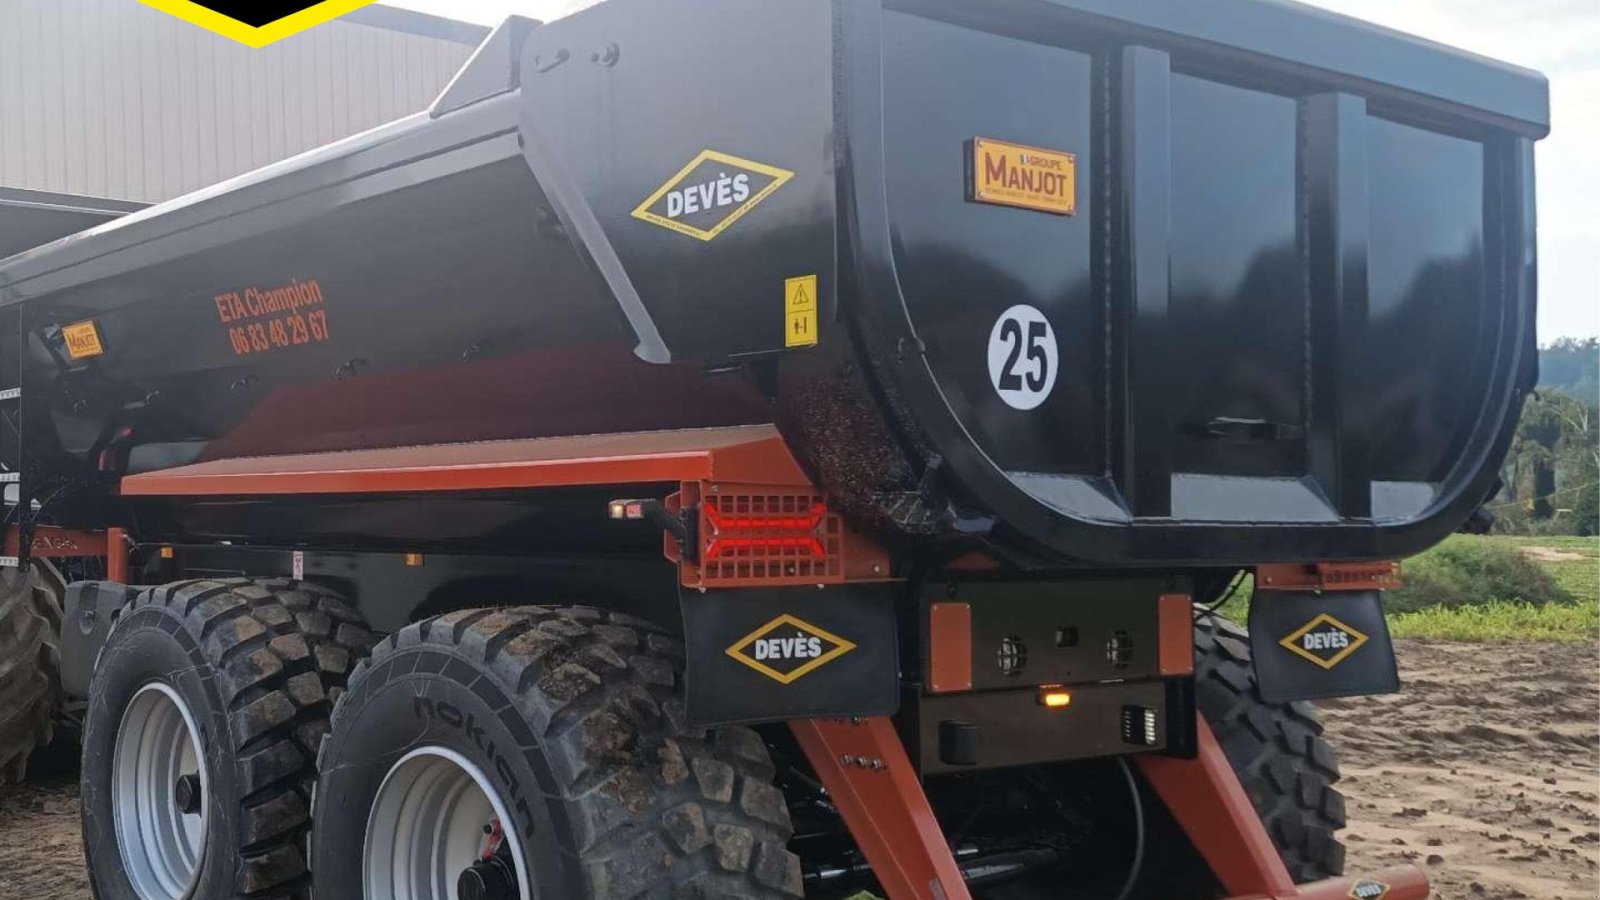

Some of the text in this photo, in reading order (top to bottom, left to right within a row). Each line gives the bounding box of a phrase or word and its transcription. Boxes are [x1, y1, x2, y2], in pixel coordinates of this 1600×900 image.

[1029, 155, 1063, 171] GROUPE
[667, 172, 750, 218] DEVÈS
[215, 278, 323, 322] ETA Champion
[230, 309, 329, 355] 06 83 48 29 67
[998, 317, 1048, 393] 25
[755, 631, 822, 660] DEVÈS
[1303, 627, 1349, 650] DEVÈS
